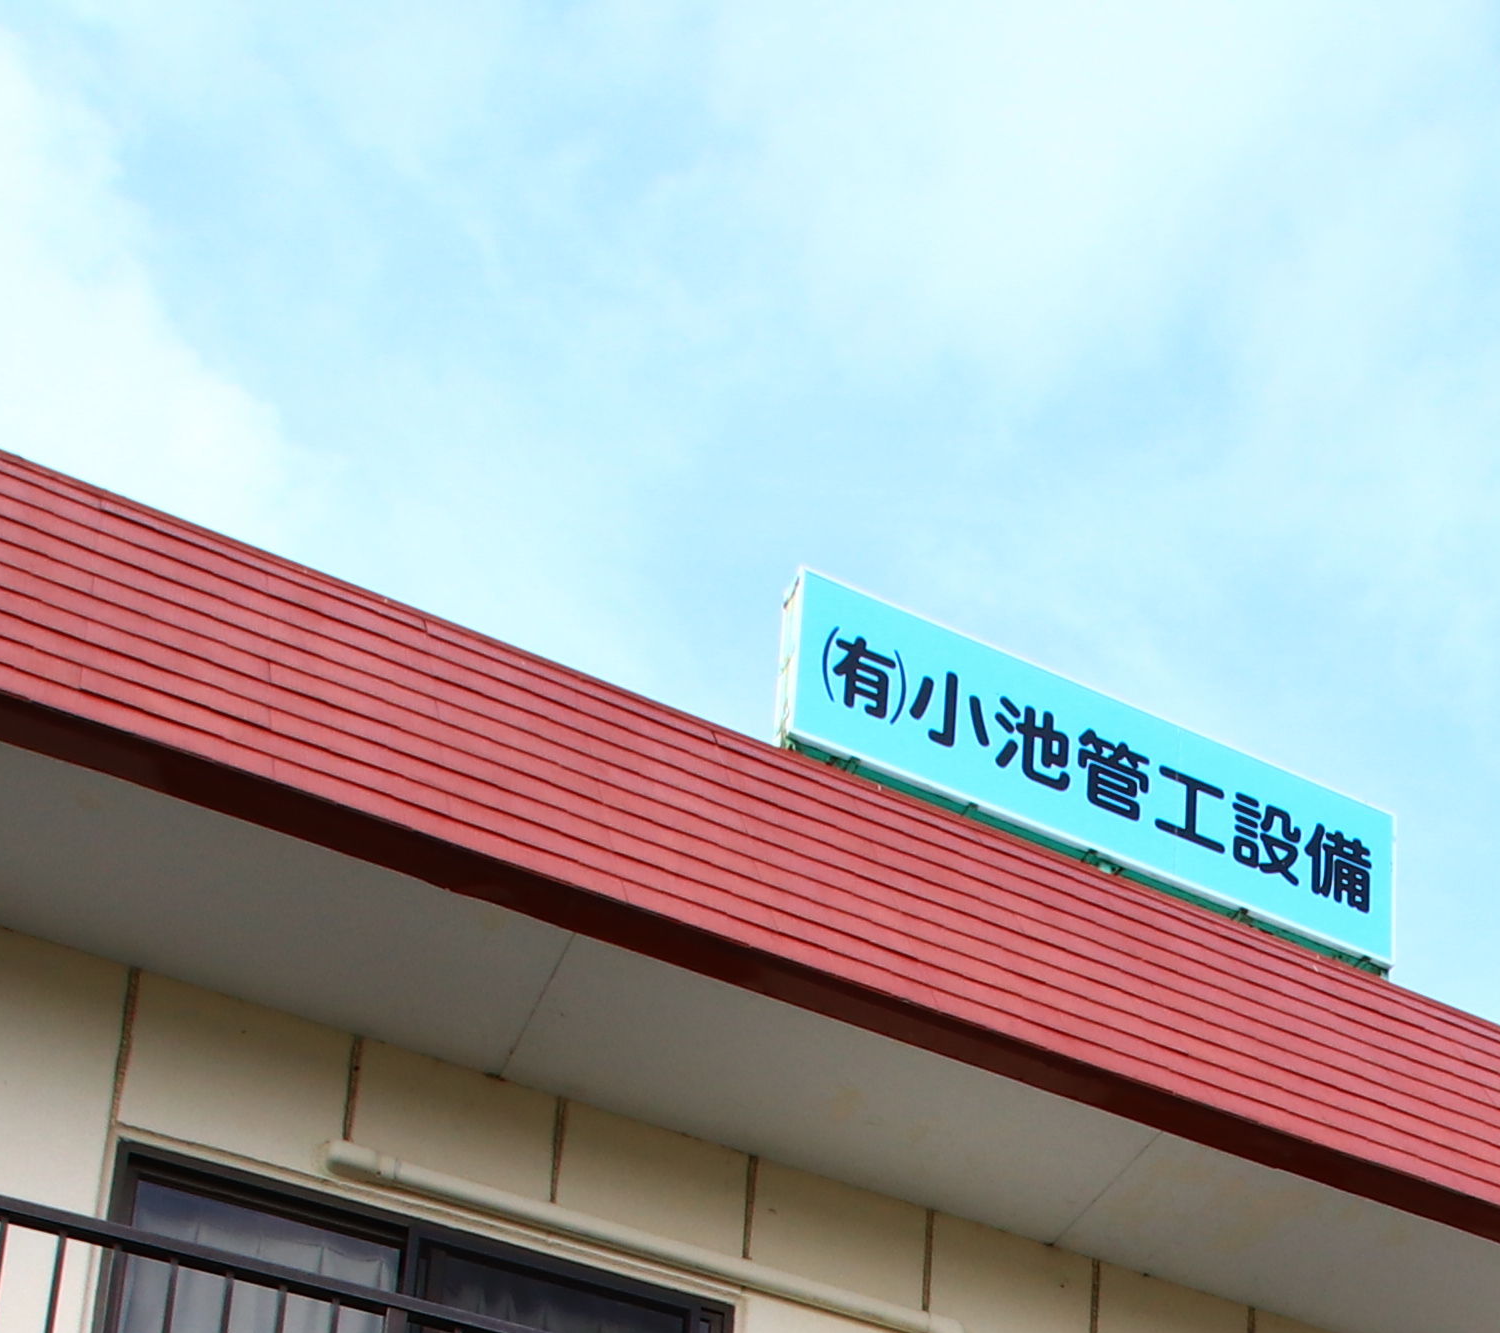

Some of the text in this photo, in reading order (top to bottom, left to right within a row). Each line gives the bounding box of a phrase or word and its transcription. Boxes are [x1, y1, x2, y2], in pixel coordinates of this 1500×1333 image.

[821, 626, 1372, 914] (有)小池管工設備
